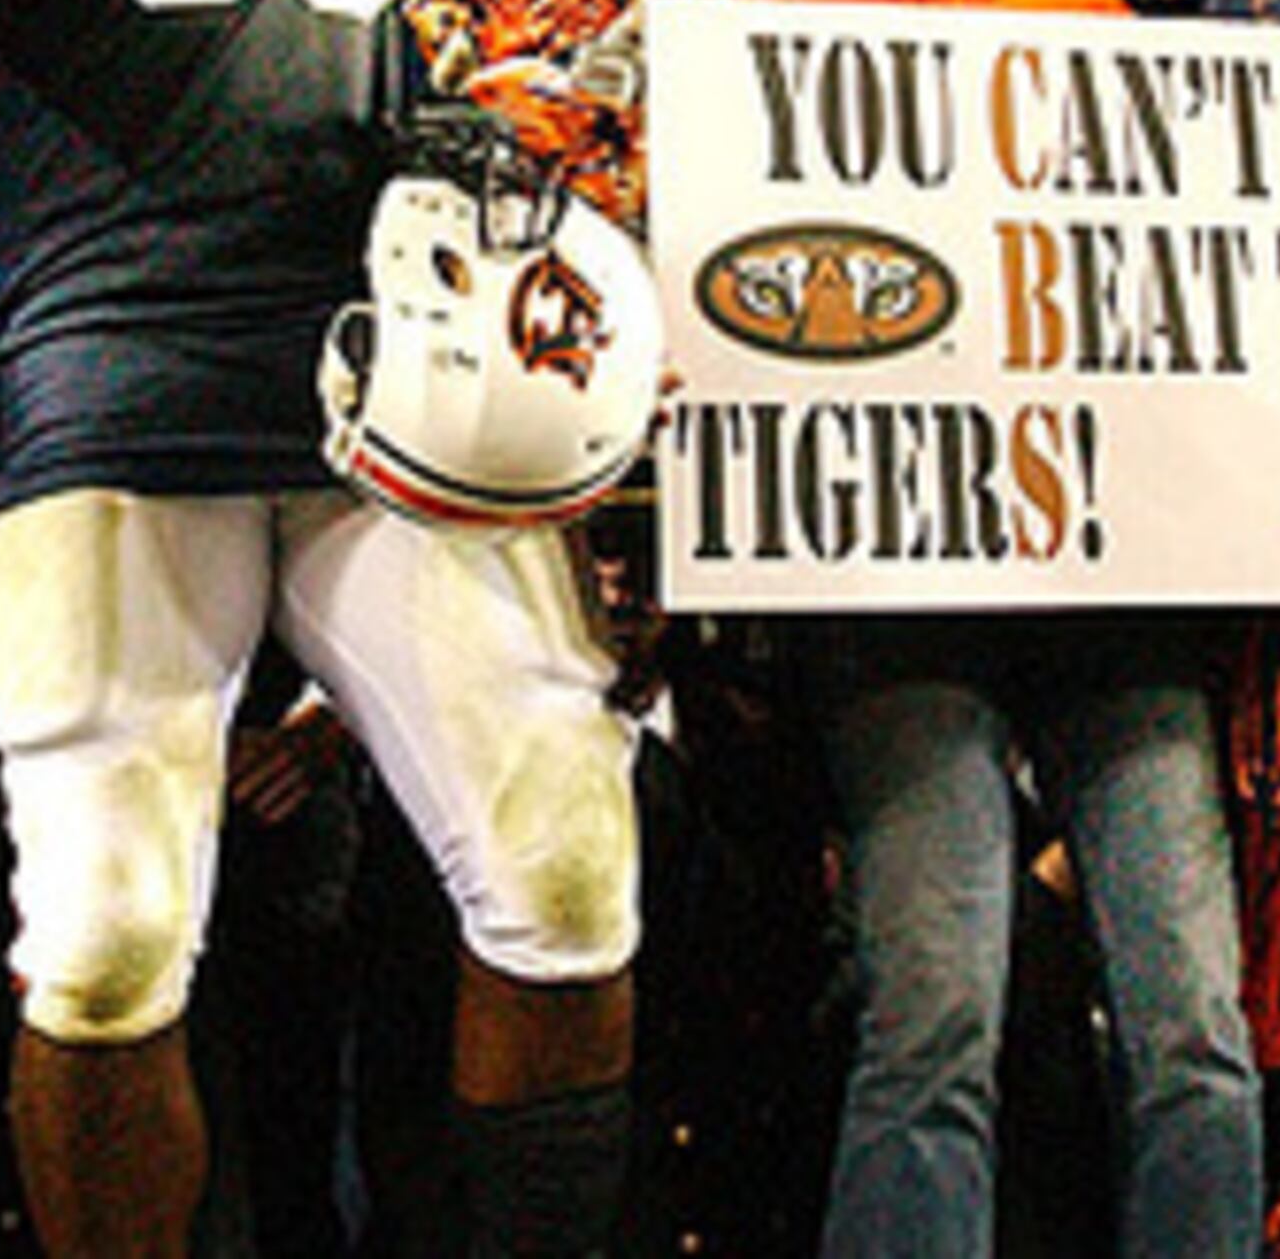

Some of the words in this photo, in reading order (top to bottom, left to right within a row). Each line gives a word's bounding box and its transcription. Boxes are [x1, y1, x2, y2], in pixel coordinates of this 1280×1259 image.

[747, 32, 953, 189] YOU
[988, 44, 1277, 200] CAN'T
[993, 218, 1255, 375] BEAT
[676, 400, 1104, 563] TIGERS!
